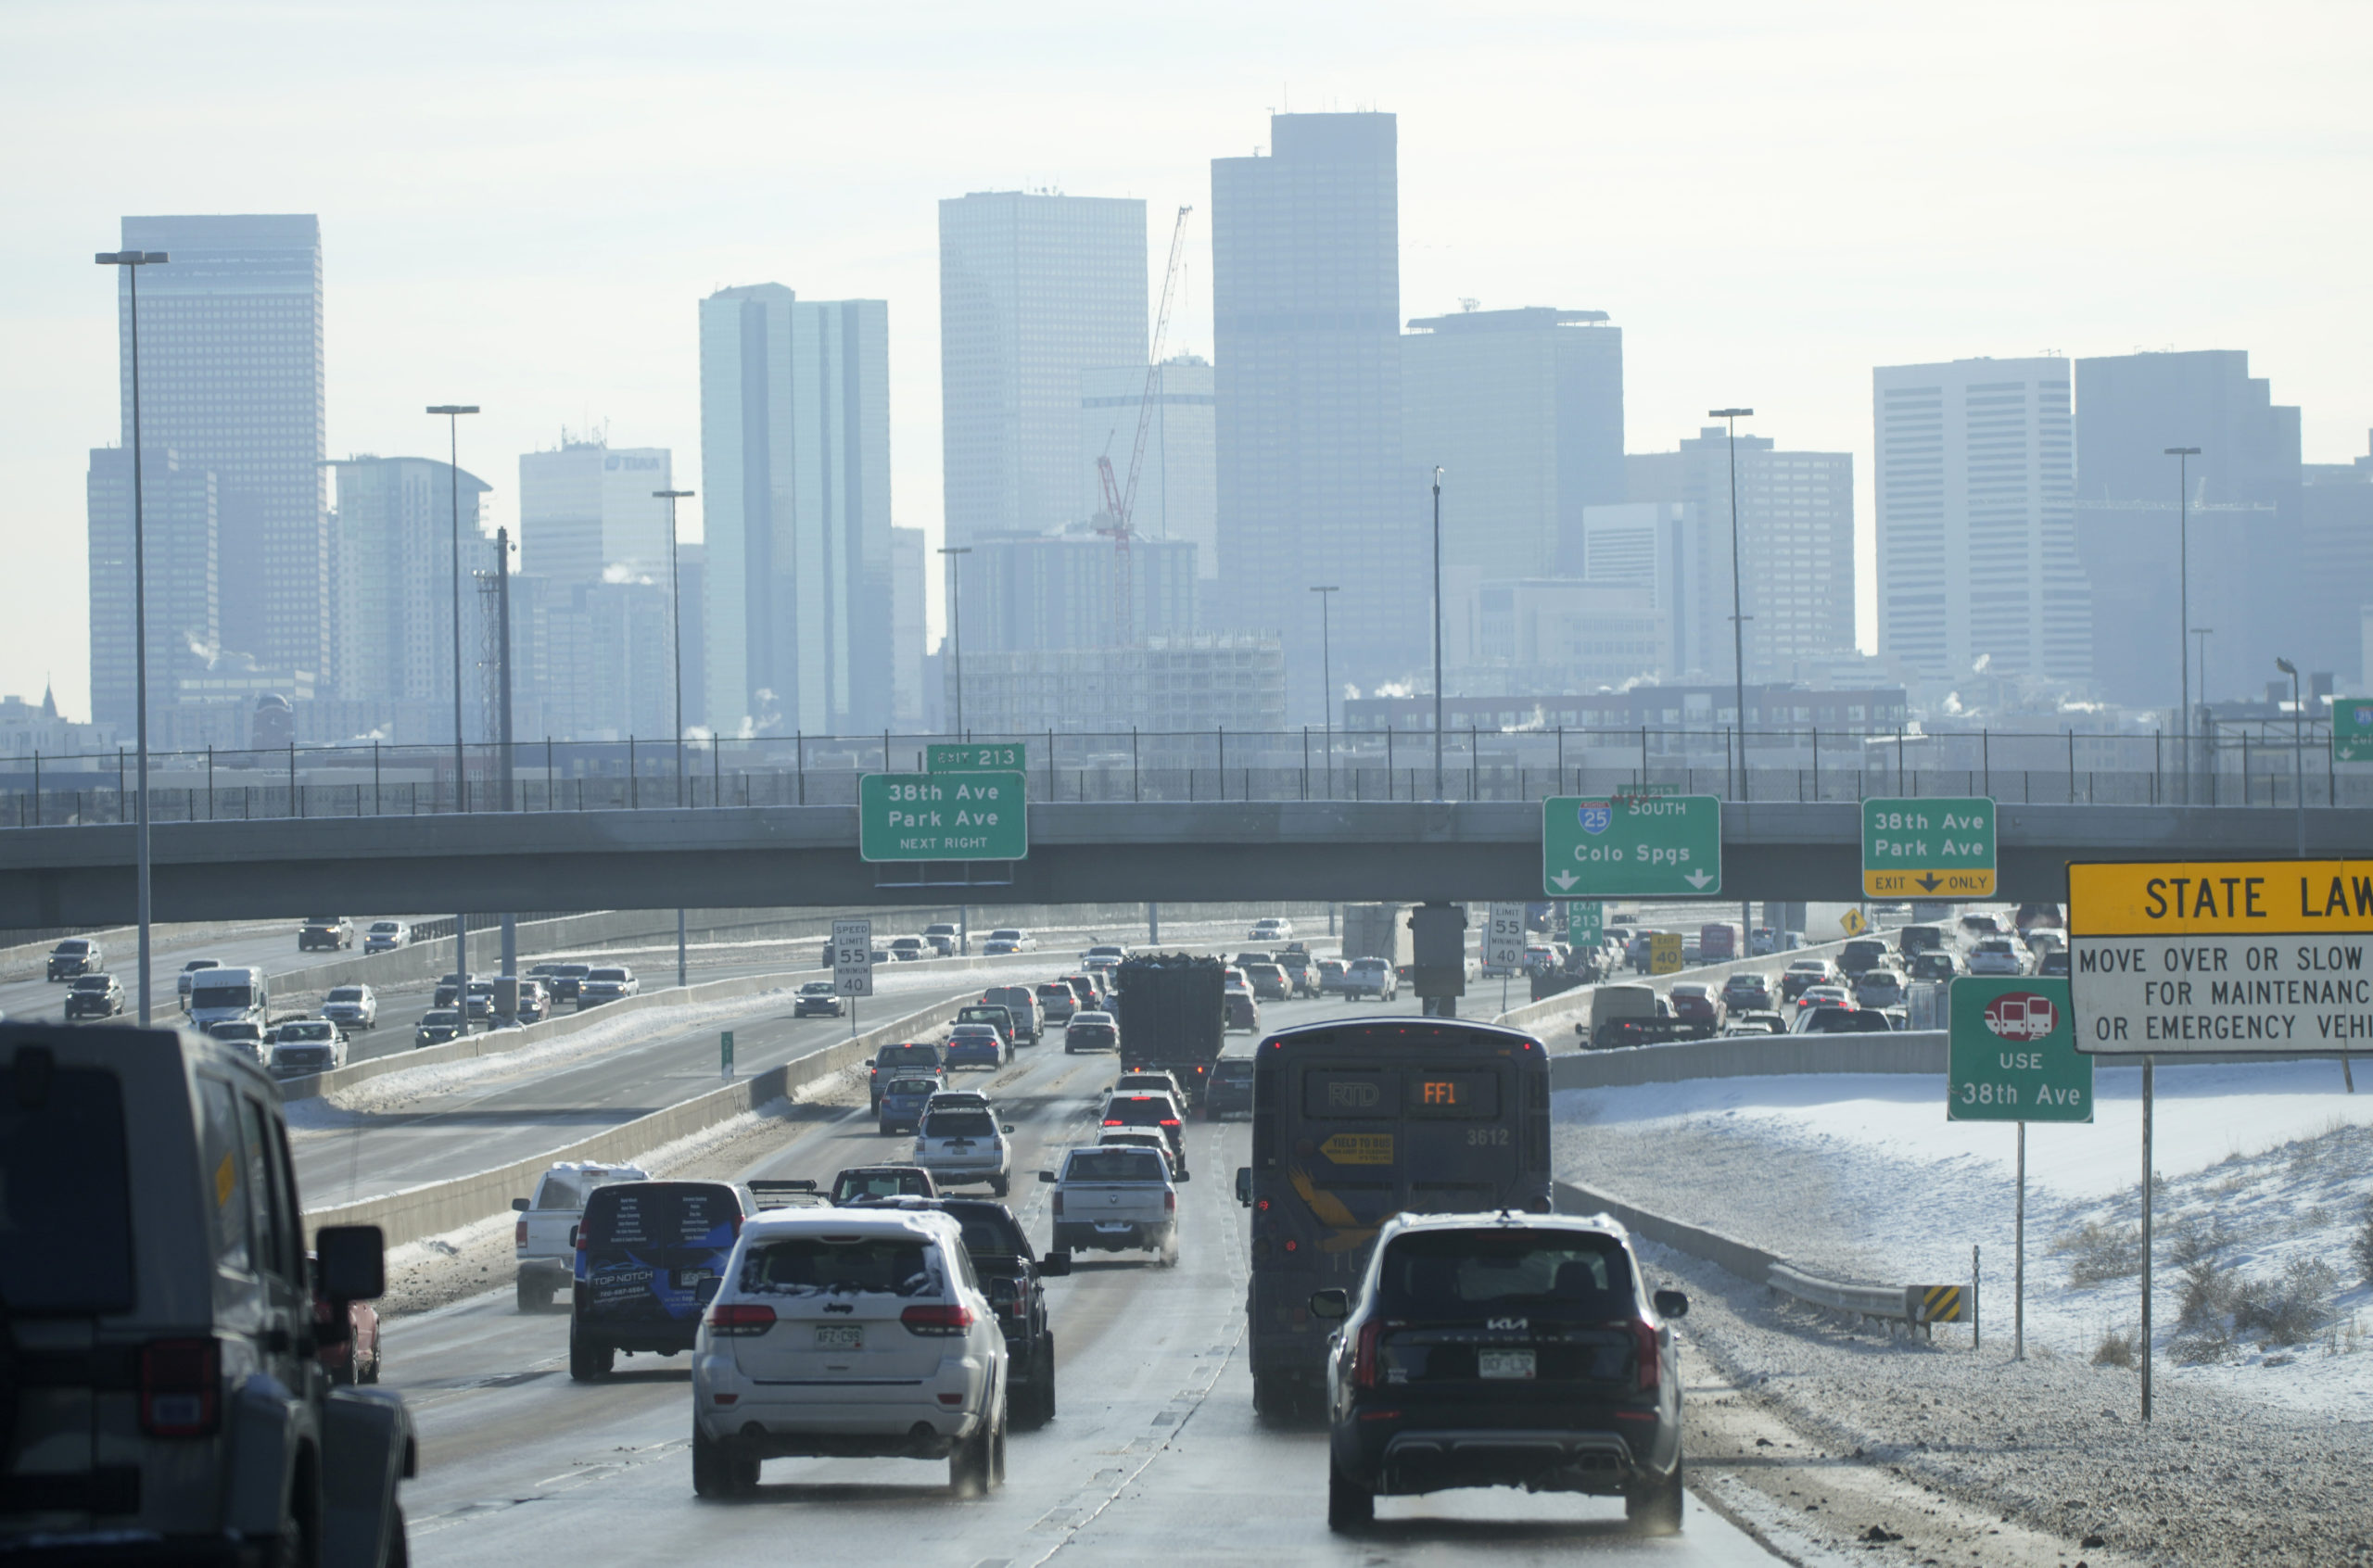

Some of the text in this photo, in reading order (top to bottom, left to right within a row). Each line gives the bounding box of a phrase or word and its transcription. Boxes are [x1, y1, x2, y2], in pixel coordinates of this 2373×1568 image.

[937, 750, 1015, 765] EXIT 213
[888, 784, 999, 802] 38th Ave
[889, 810, 998, 828] Park Ave
[1584, 800, 1686, 828] 25 SOUTH
[1874, 813, 1985, 829] 38th Ave
[900, 837, 987, 850] NEXT RIGHT
[1875, 839, 1984, 856] Park Ave
[1574, 844, 1690, 866] Colo Spgs
[1875, 877, 1987, 890] EXIT ONLY
[2145, 876, 2373, 919] STATE LAW
[1496, 908, 1519, 917] LIMIT
[1572, 903, 1597, 912] EXIT
[1495, 919, 1519, 934] 55
[1572, 915, 1600, 927] 213
[836, 925, 868, 934] SPEED
[840, 937, 864, 945] LIMIT
[1491, 938, 1522, 946] MINIMUM
[840, 949, 865, 964] 55
[1497, 949, 1516, 963] 40
[1656, 951, 1677, 965] 40
[2079, 945, 2363, 973] MOVE OVER OR SLOW
[837, 967, 869, 975] MINIMUM
[844, 979, 863, 991] 40
[2146, 981, 2192, 1005] FOR
[2096, 1017, 2128, 1041] OR
[2147, 1015, 2296, 1040] EMERGENCY
[1999, 1053, 2043, 1069] USE
[1328, 1082, 1379, 1106] RTD
[1424, 1081, 1456, 1105] FF1
[1961, 1082, 2081, 1106] 38th Ave
[1333, 1137, 1390, 1147] YIELD TO BUS
[1466, 1128, 1510, 1146] 3612
[593, 1271, 654, 1285] TOP NOTCH
[823, 1302, 854, 1315] Jeep
[1487, 1317, 1529, 1331] KIA
